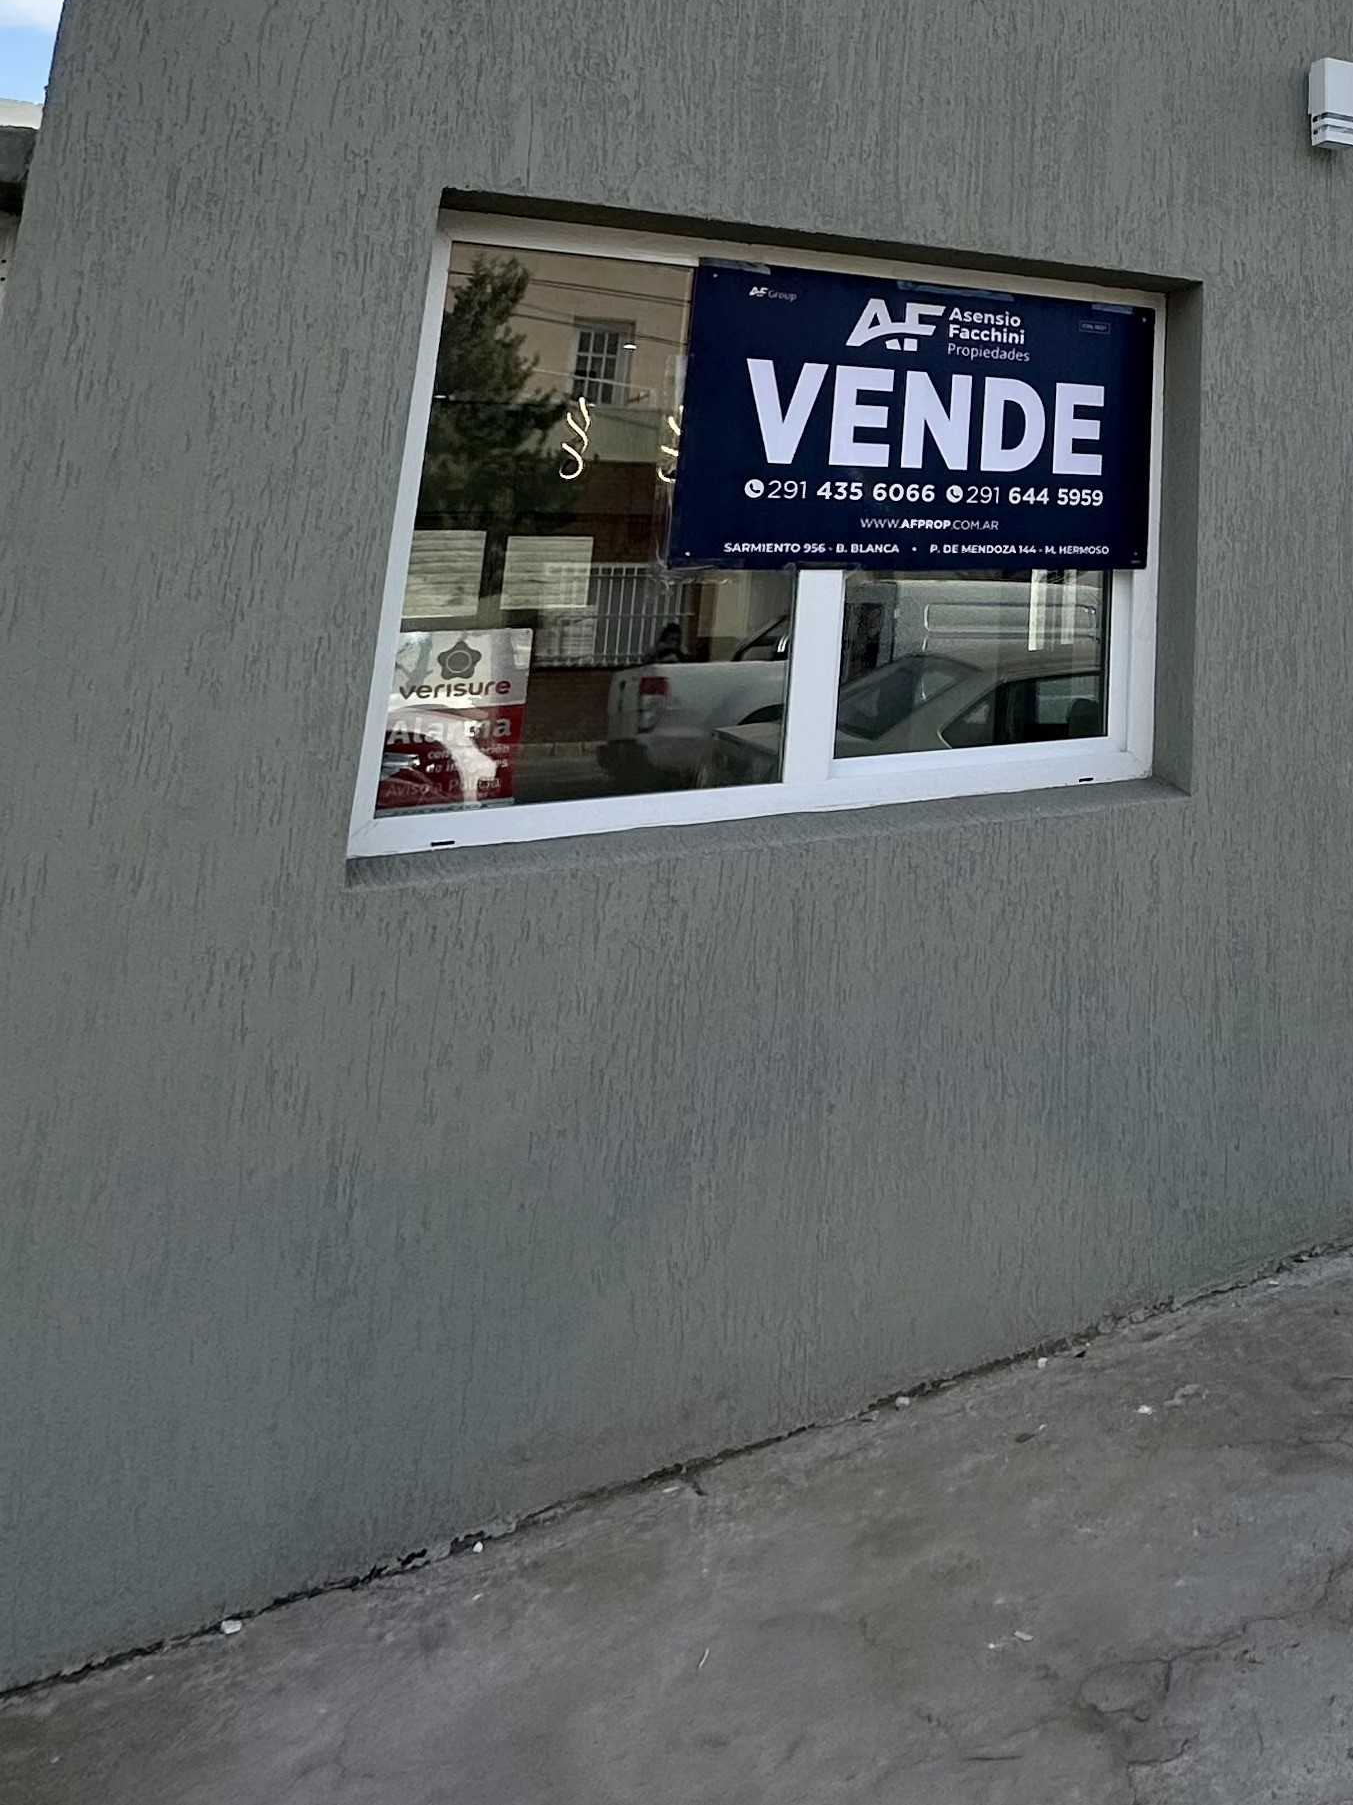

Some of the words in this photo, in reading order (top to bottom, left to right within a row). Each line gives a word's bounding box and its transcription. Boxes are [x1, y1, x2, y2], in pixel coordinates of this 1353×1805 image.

[768, 289, 797, 302] Group
[845, 298, 946, 352] AF
[948, 307, 1022, 328] Asensio
[948, 323, 1025, 345] Facchini
[947, 341, 1030, 362] Propiedades
[746, 358, 1105, 476] VENDE
[767, 479, 807, 500] 291
[816, 481, 863, 501] 435
[872, 482, 935, 503] 6066
[966, 485, 1000, 504] 291
[1008, 486, 1050, 505] 644
[1056, 488, 1104, 507] 5959
[860, 518, 999, 531] WWW.AFPROP.COM.AR
[723, 542, 801, 554] SARMIENTO
[803, 542, 827, 554] 956
[835, 543, 848, 554] B.
[850, 543, 900, 554] BLANCA
[929, 543, 940, 554] P.
[942, 544, 959, 554] DE
[961, 544, 1017, 555] MENDOZA
[1018, 544, 1037, 554] 144
[1058, 545, 1110, 555] HERMOSO
[399, 680, 511, 700] verisure
